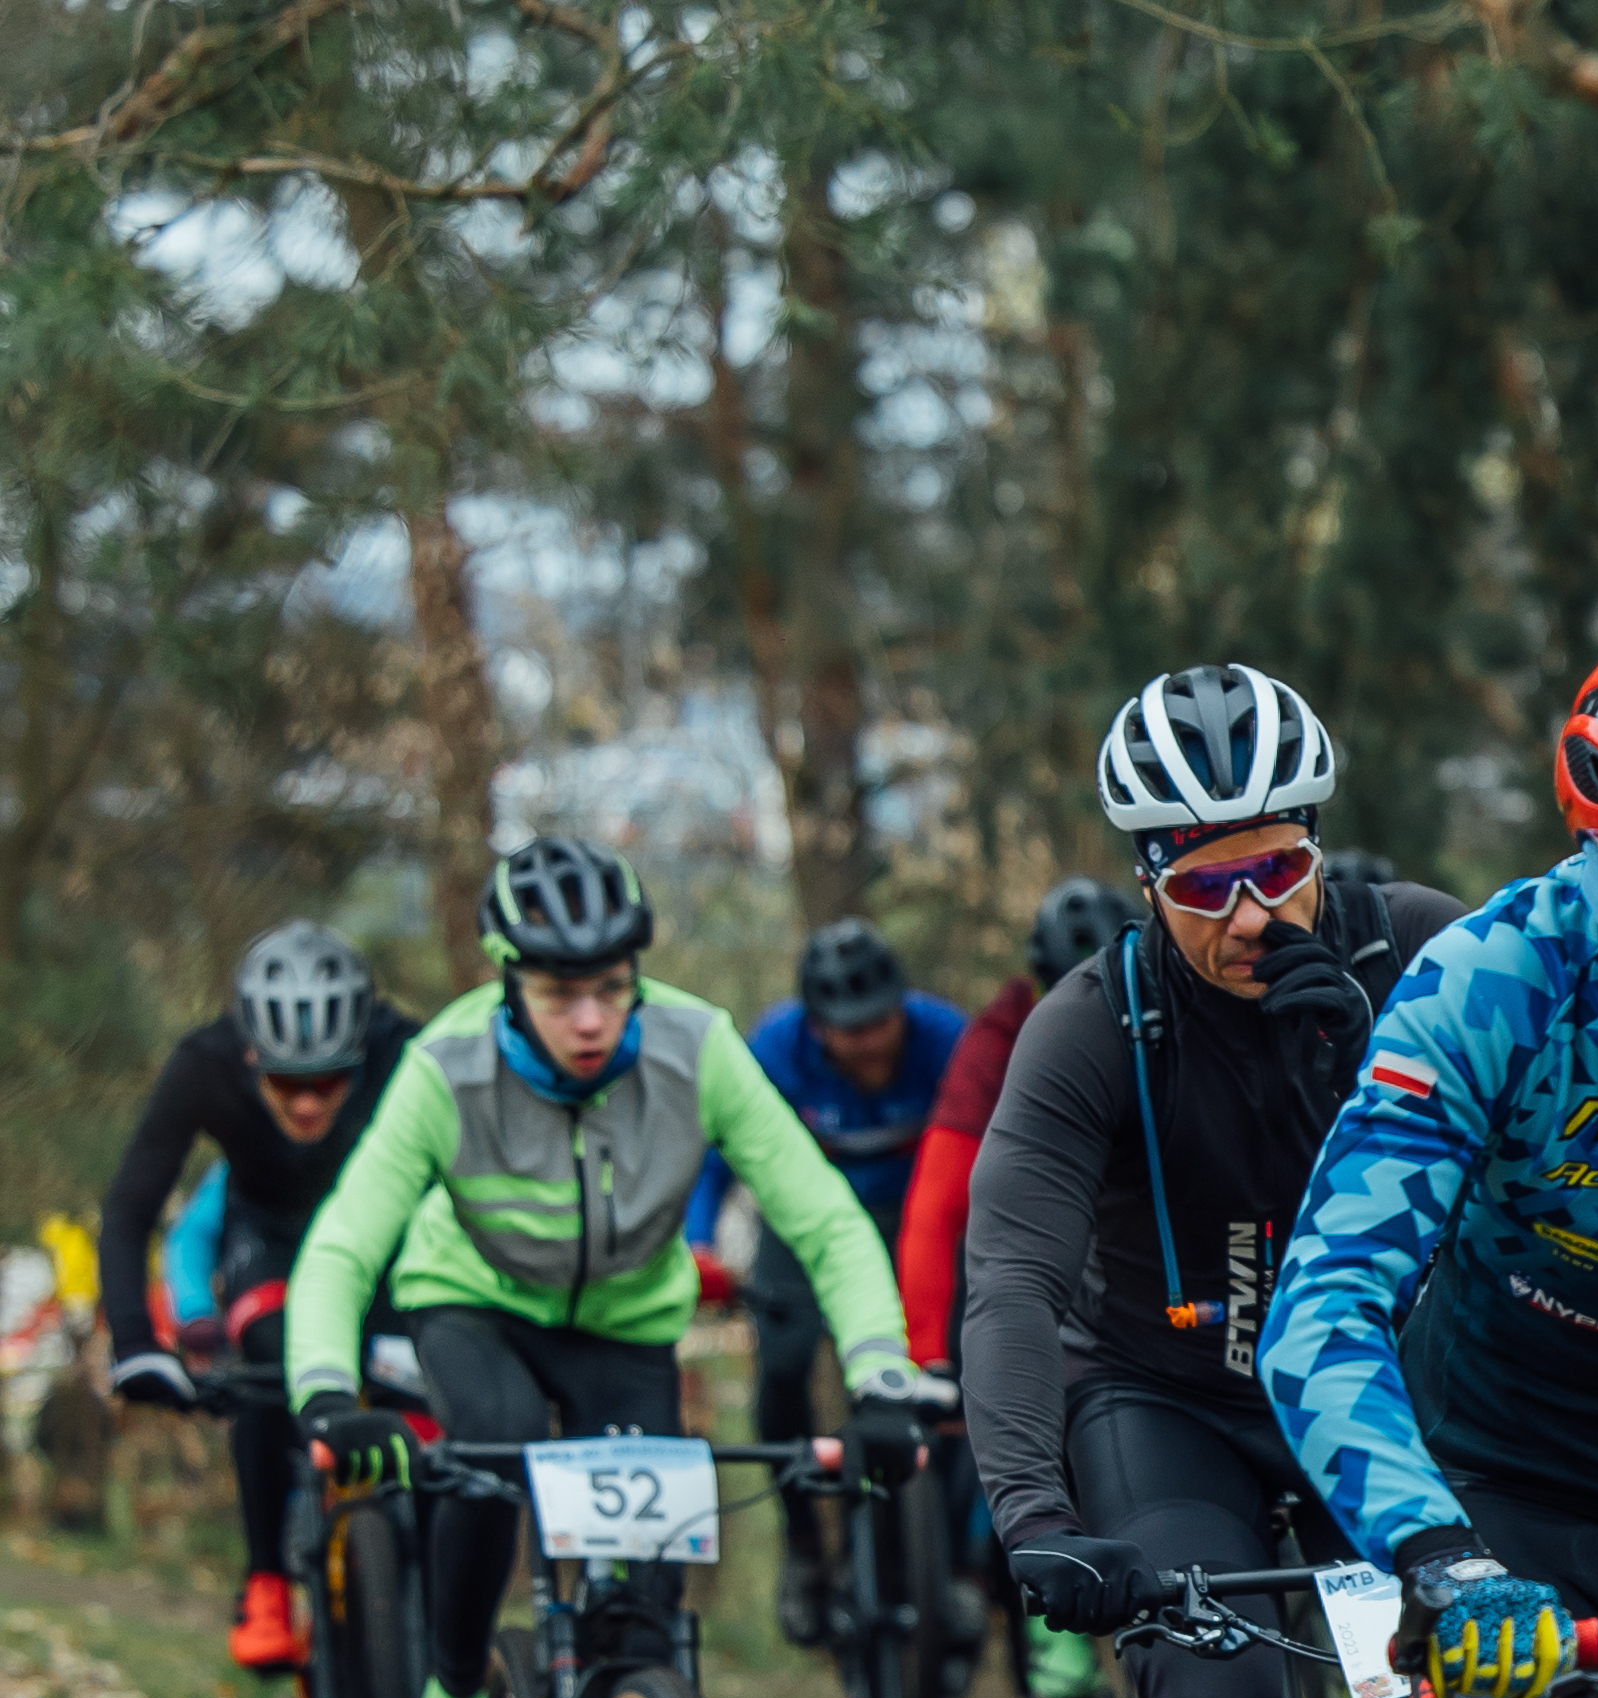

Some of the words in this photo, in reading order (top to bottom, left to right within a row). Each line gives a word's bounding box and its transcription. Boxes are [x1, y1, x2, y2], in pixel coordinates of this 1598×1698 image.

[591, 1467, 666, 1520] 52
[1325, 1570, 1375, 1596] MTB
[1338, 1622, 1359, 1656] 2023
